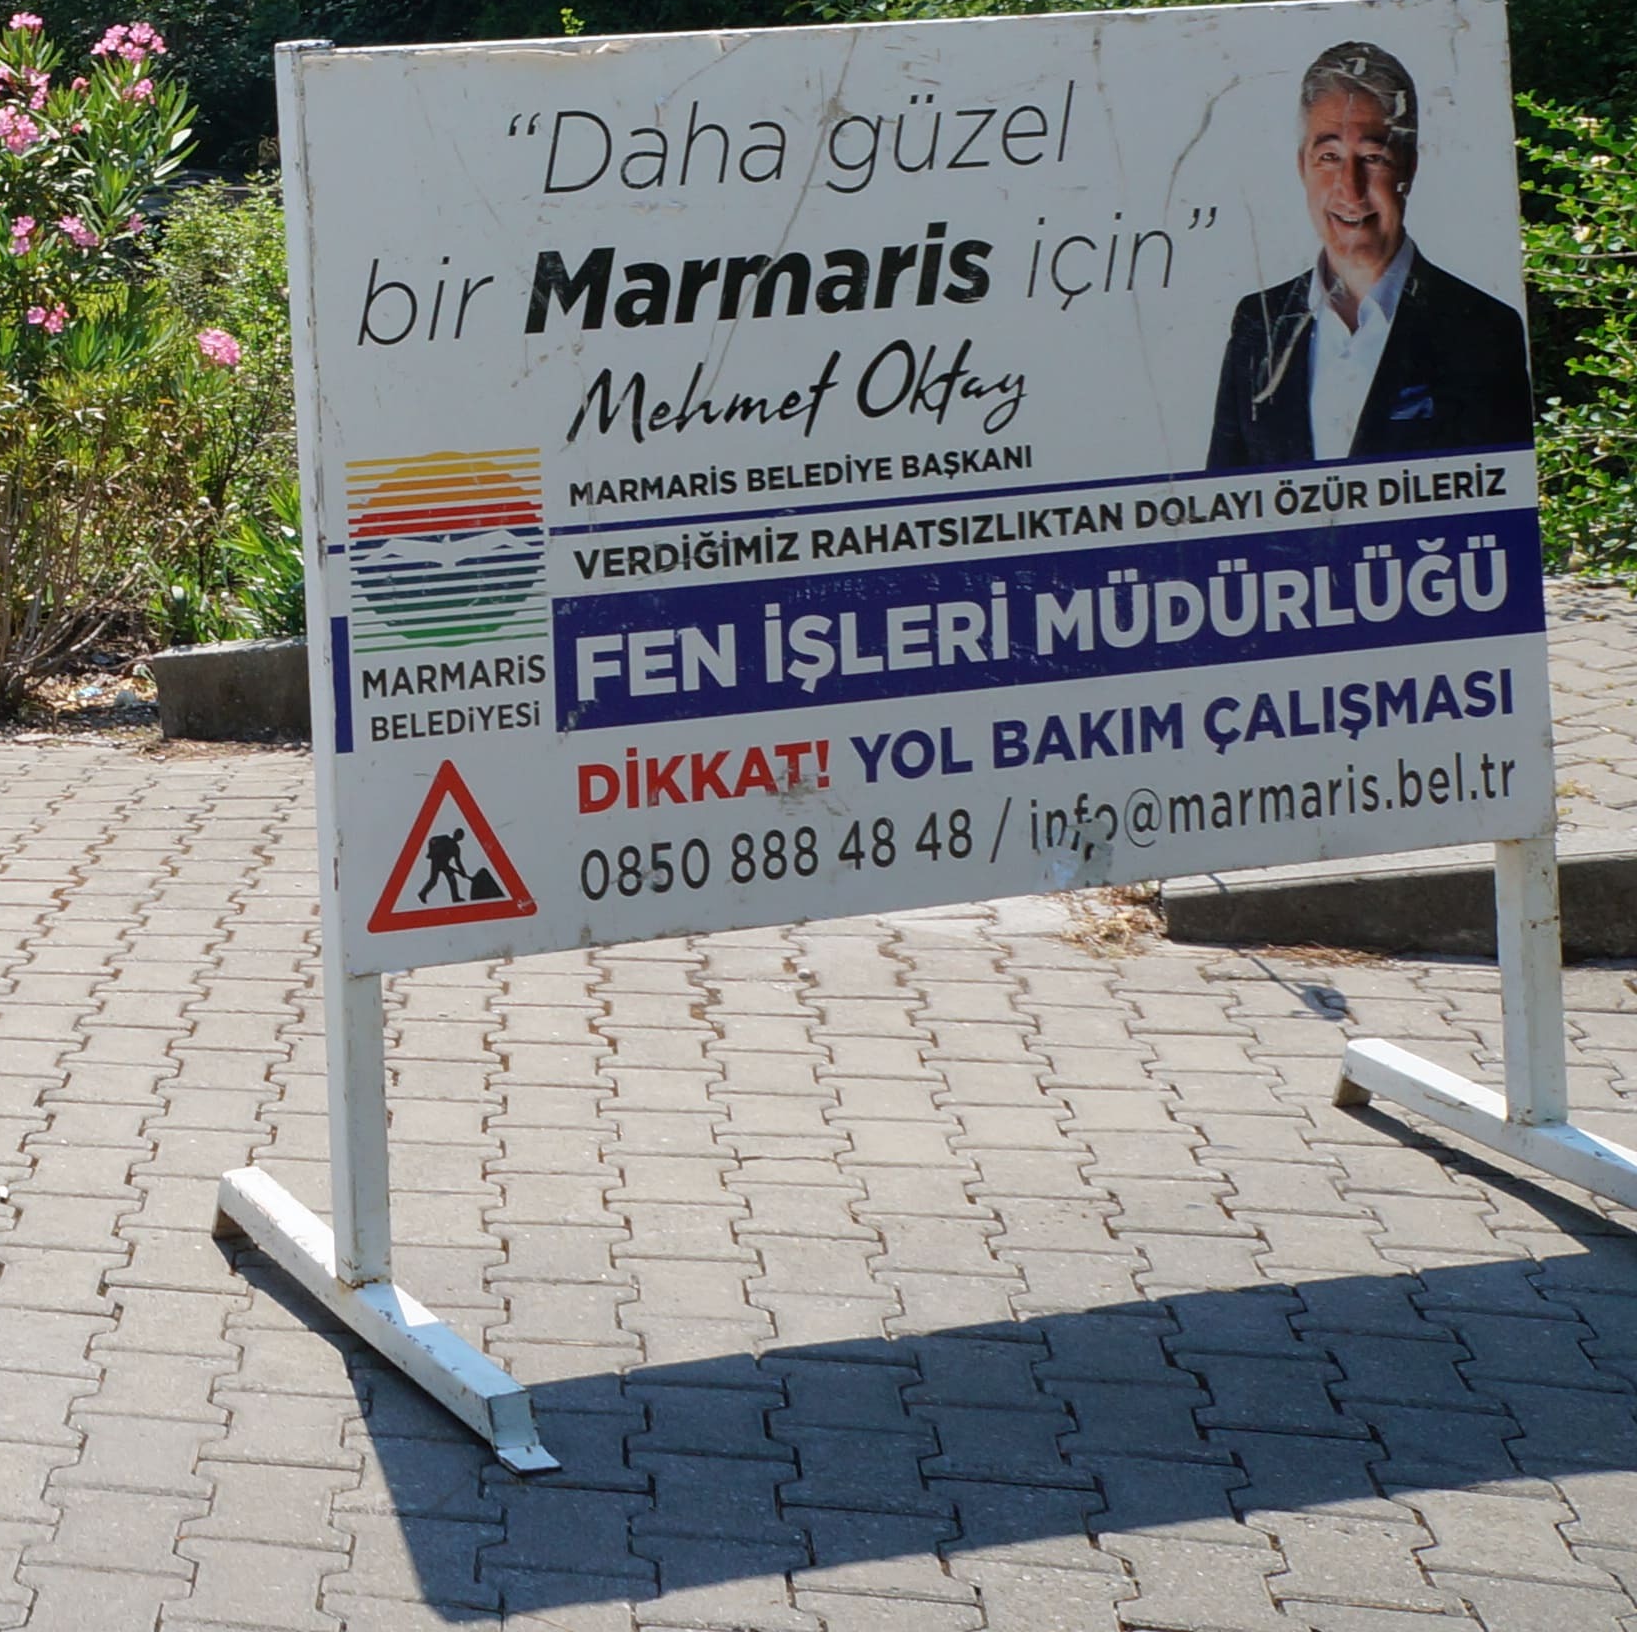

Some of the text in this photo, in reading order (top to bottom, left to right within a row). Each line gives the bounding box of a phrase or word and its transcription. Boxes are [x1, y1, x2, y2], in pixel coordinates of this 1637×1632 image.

[507, 79, 1074, 194] “Daha güzel
[357, 205, 1218, 346] bir Marmaris için”
[565, 337, 1027, 444] Mehmet Oktay
[569, 444, 1033, 508] MARMARİS BELEDİYE BAŞKANI
[573, 466, 1507, 580] VERDİĞİMİZ RAHATSIZLIKTAN DOLAYI ÖZÜR DİLERİZ
[575, 534, 1509, 701] FEN İŞLERİ MÜDÜRLÜĞÜ
[578, 668, 1513, 814] DİKKAT! YOL BAKIM ÇALIŞMASI
[580, 843, 710, 901] 0850
[730, 825, 819, 884] 888
[838, 818, 896, 871] 48
[915, 808, 974, 861] 48
